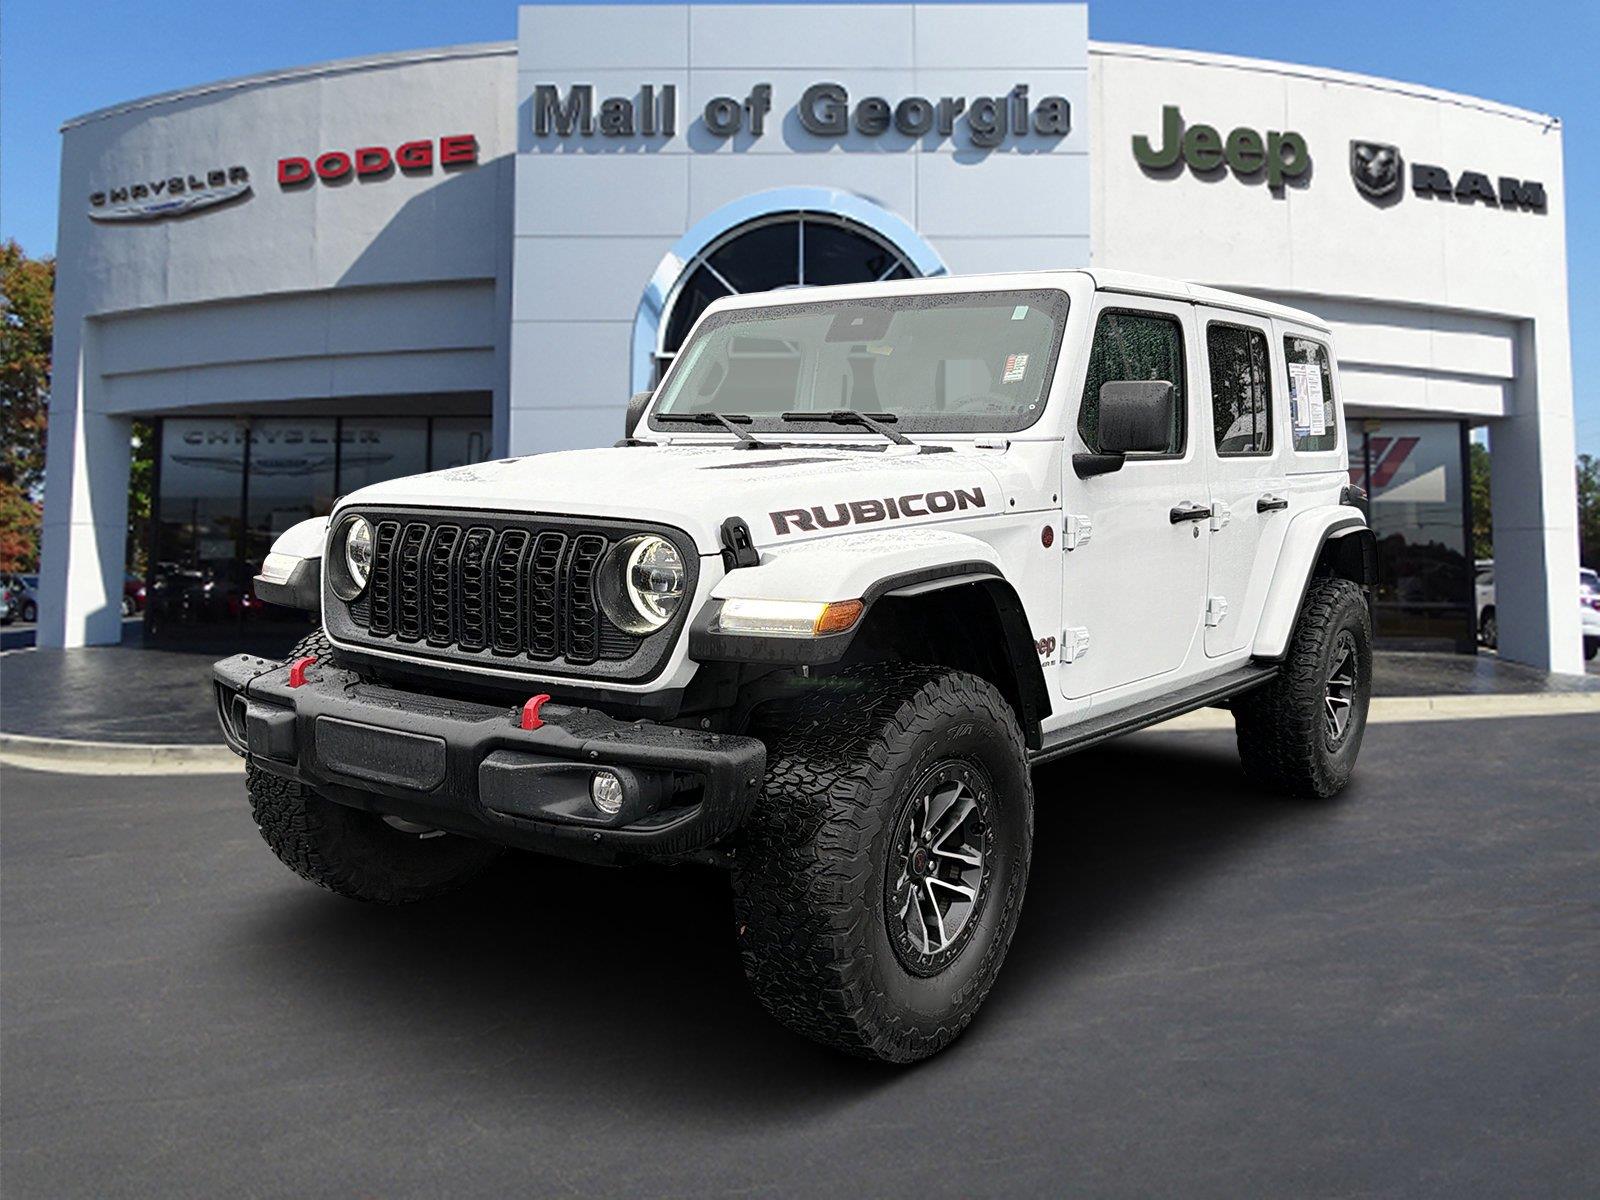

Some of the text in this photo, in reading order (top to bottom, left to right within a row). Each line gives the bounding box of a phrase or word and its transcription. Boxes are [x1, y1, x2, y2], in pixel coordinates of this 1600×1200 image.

[533, 83, 1073, 147] Mall of Georgia
[277, 134, 478, 189] DODGE
[1131, 105, 1310, 189] Jeep
[89, 165, 250, 207] CHRYSLER
[1411, 163, 1547, 212] RAM
[183, 431, 381, 445] CHRYSLER
[769, 487, 987, 536] RUBICON
